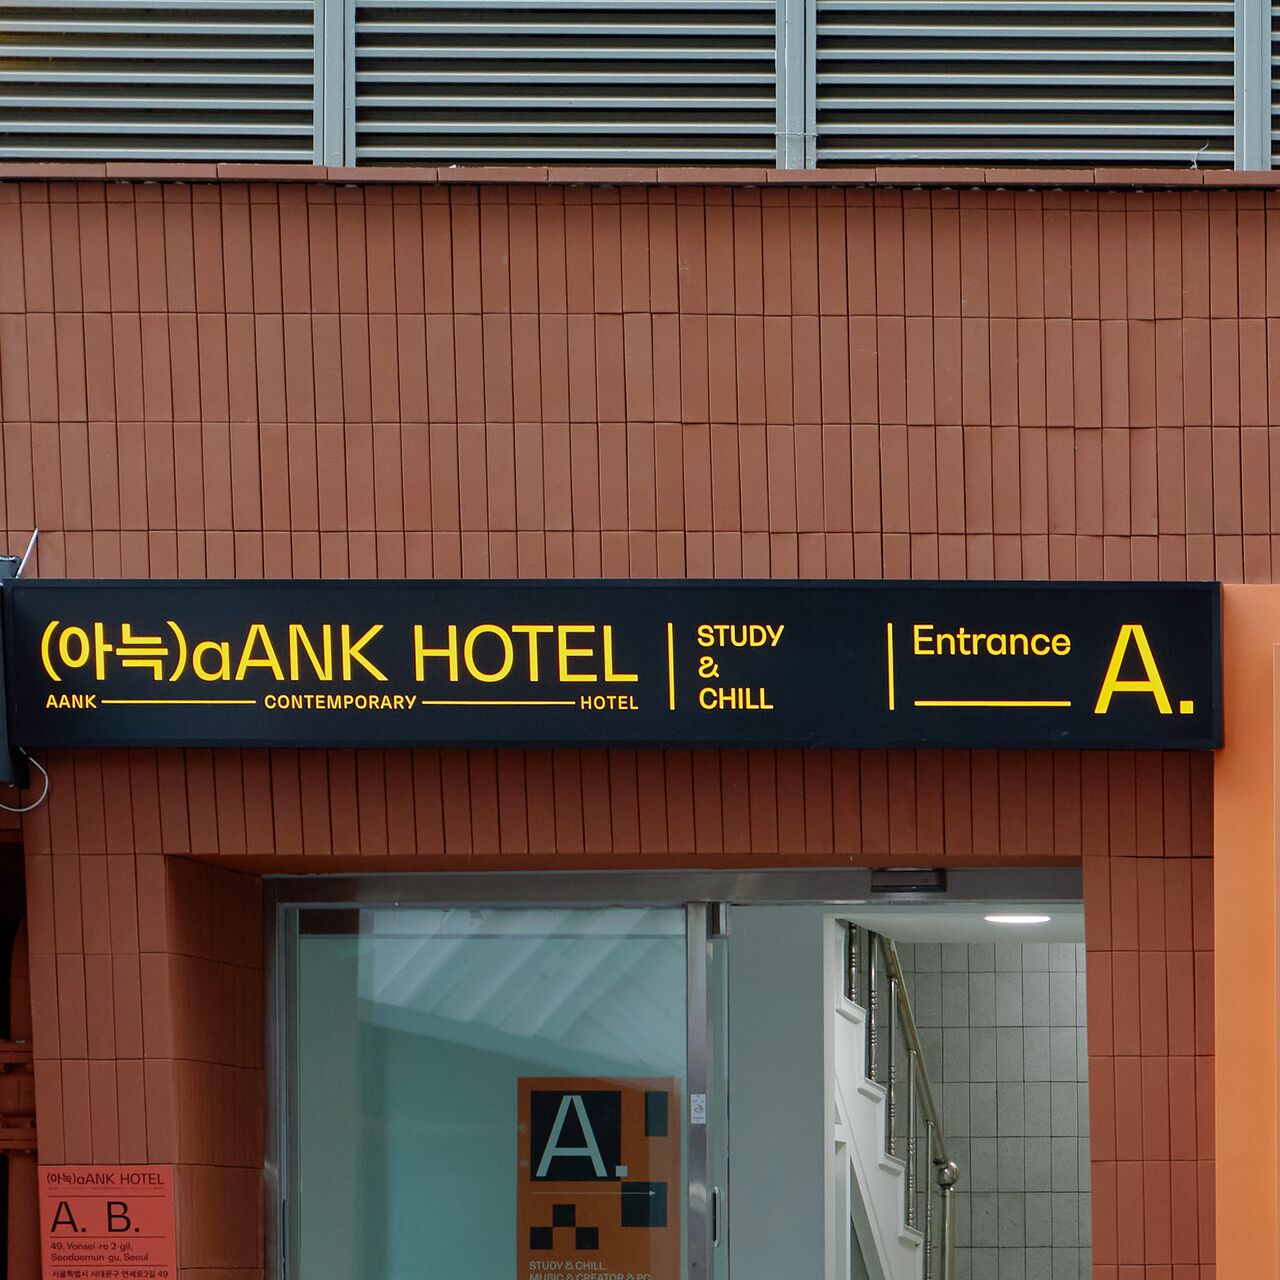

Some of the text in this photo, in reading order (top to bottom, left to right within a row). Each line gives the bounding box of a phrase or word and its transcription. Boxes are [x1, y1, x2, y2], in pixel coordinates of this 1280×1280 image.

[698, 625, 784, 646] STUDY
[914, 625, 1070, 655] Entrance
[41, 621, 638, 682] (아늑)aANK HOTEL
[699, 656, 719, 678] &
[1095, 625, 1193, 714] A.
[46, 695, 96, 708] AANK
[265, 695, 416, 709] CONTEMPORARY
[581, 696, 638, 709] HOTEL
[699, 688, 773, 709] CHILL
[536, 1095, 628, 1177] A.
[120, 1173, 164, 1185] HOTEL
[51, 1201, 139, 1232] A. B.
[529, 1261, 564, 1270] STUDY
